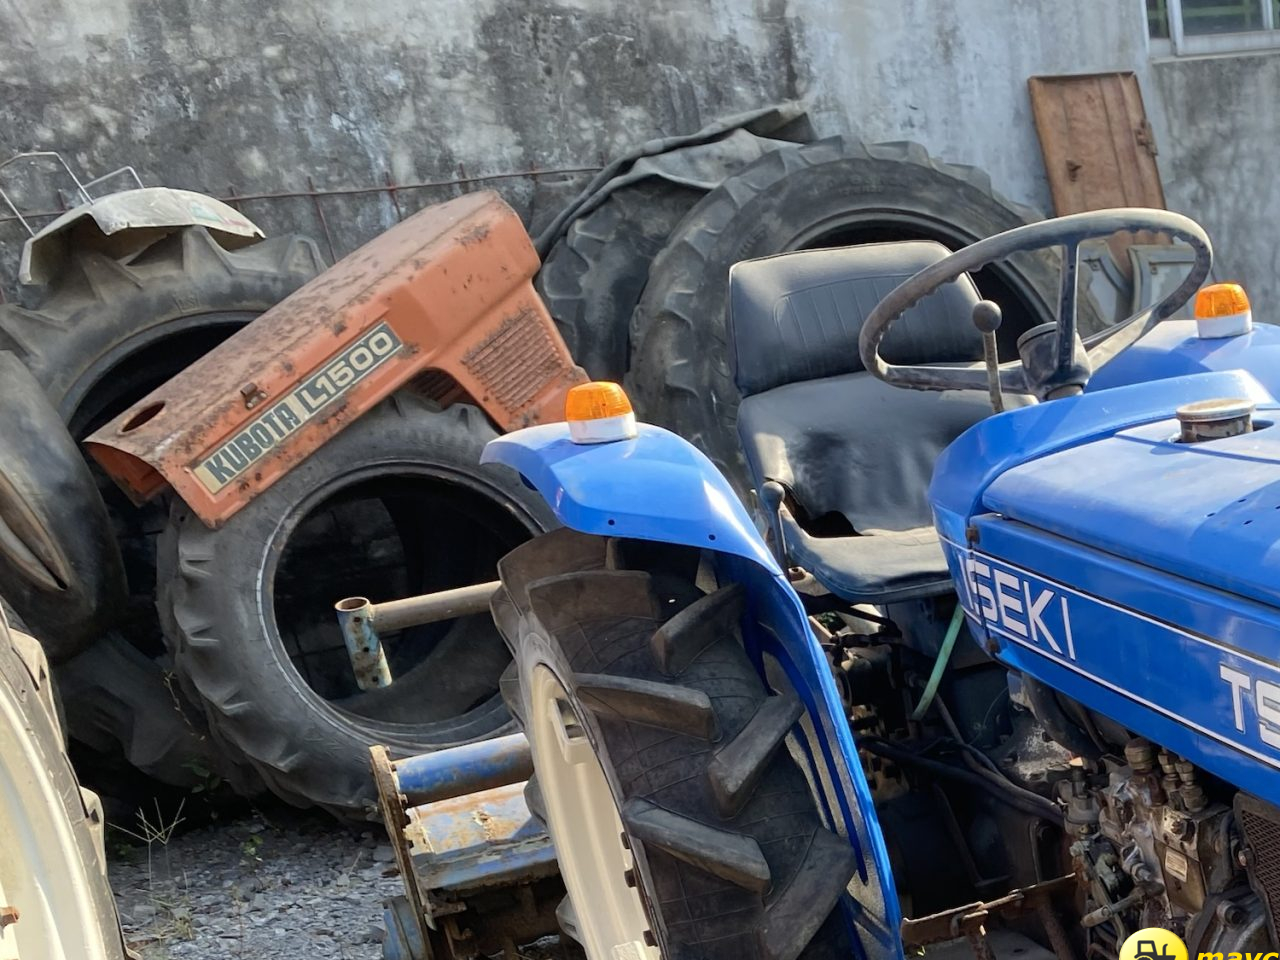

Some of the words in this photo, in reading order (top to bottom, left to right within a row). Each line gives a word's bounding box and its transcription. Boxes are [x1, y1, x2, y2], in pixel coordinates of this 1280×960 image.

[204, 402, 302, 484] KUBOTA
[300, 331, 394, 408] L1500
[958, 554, 1076, 661] ISEKI
